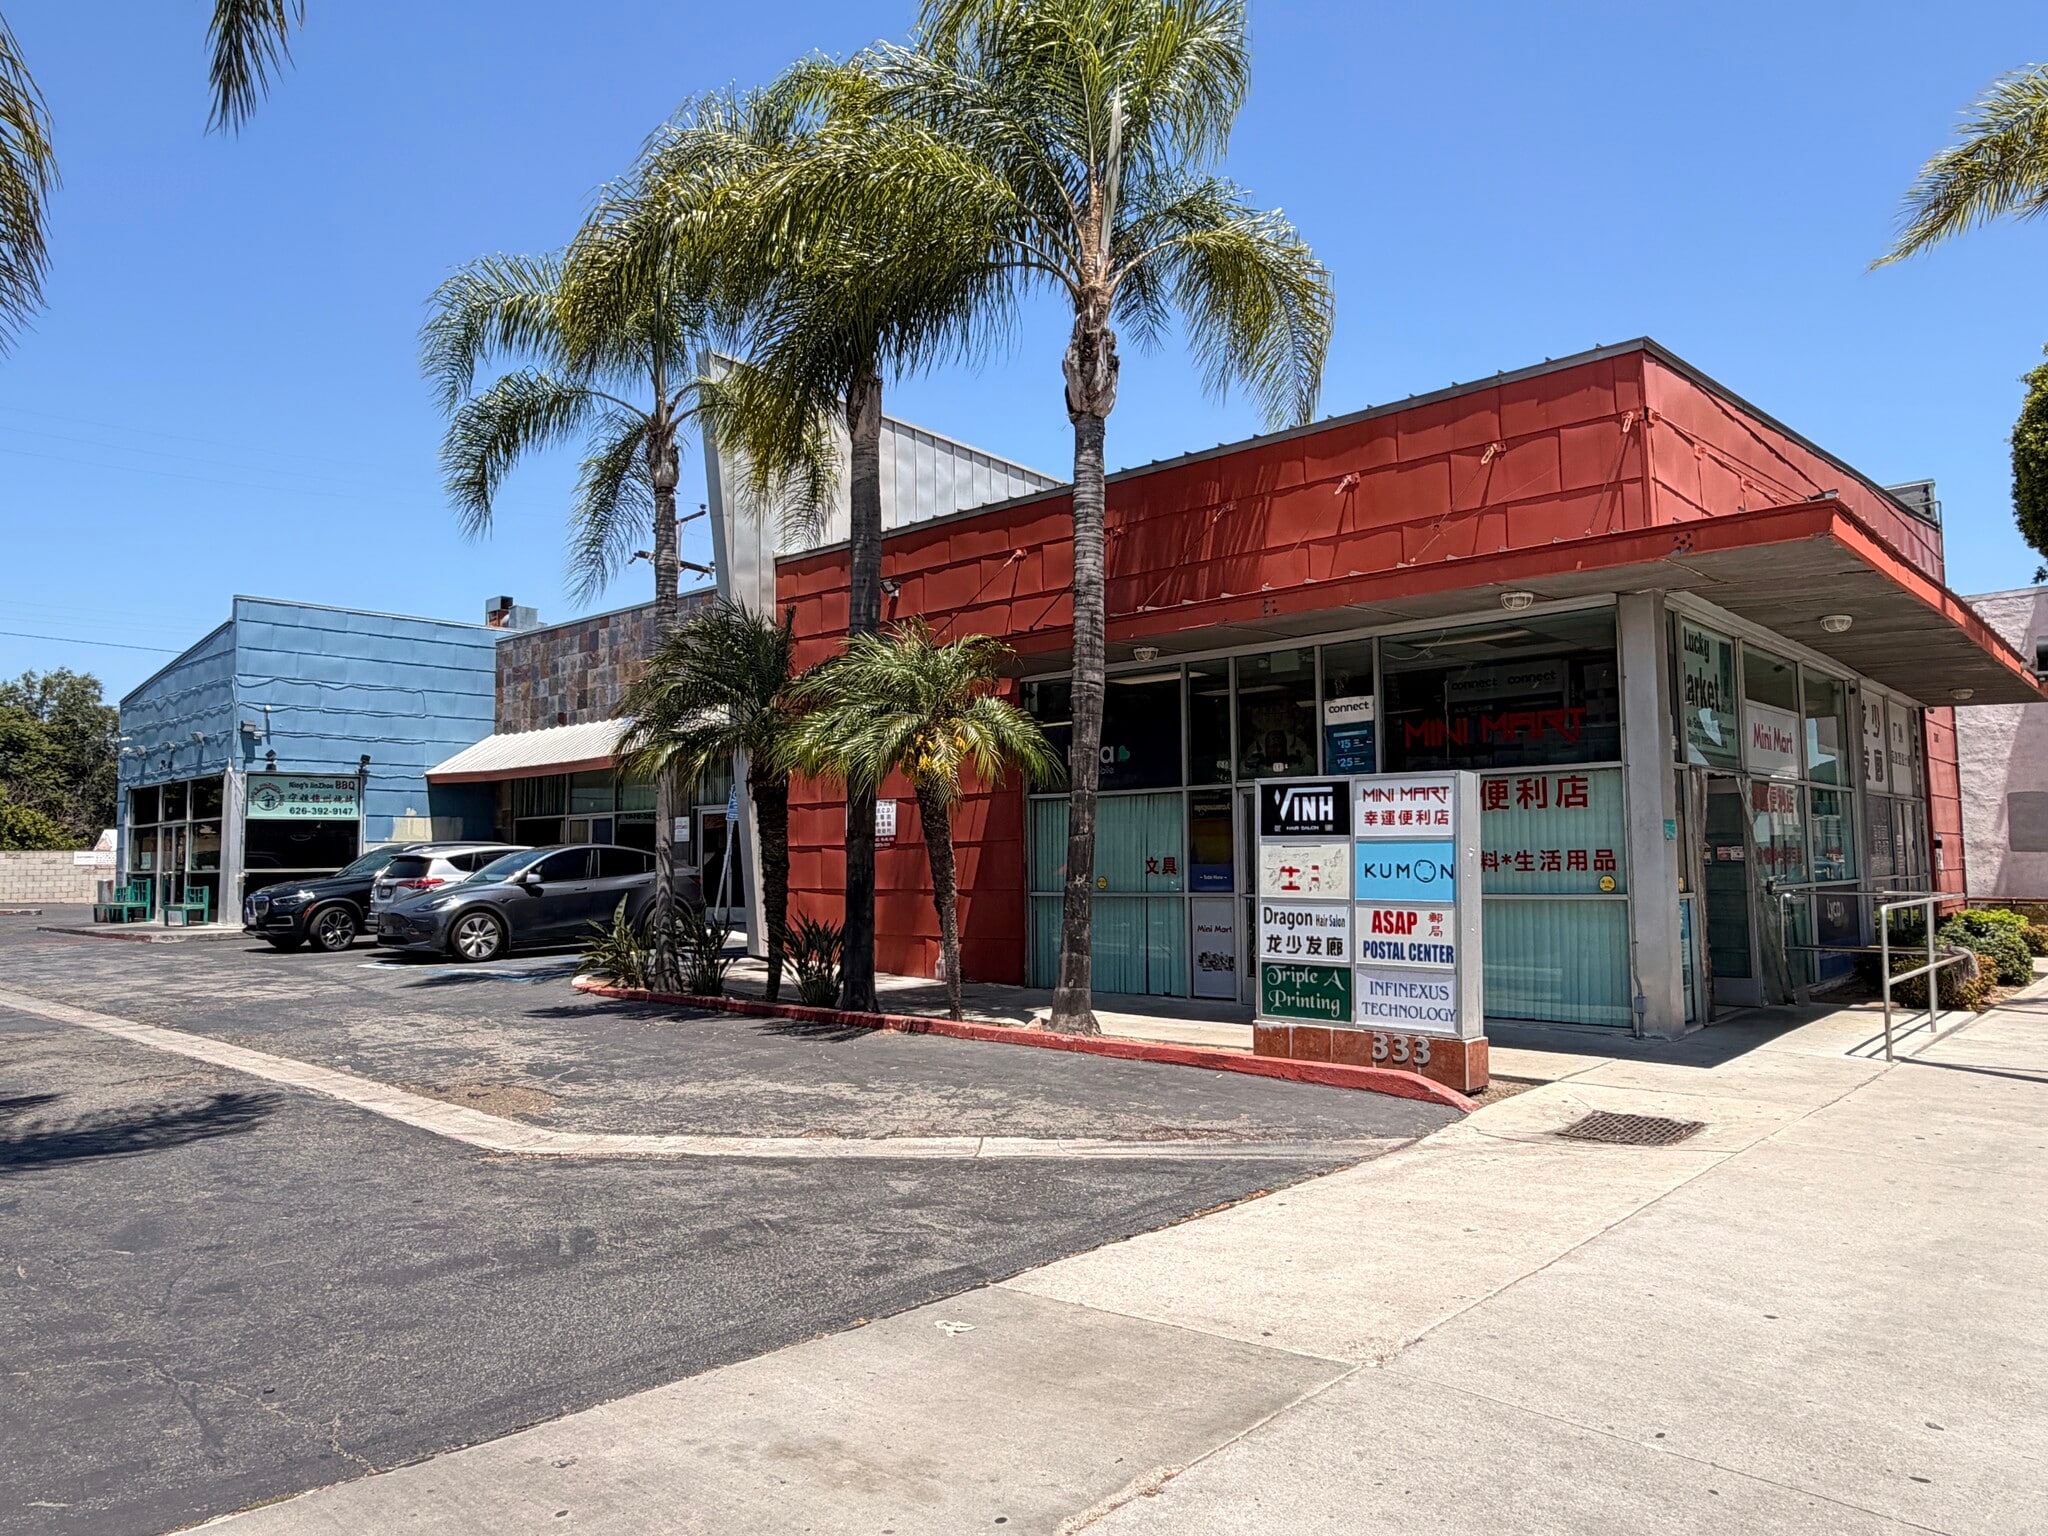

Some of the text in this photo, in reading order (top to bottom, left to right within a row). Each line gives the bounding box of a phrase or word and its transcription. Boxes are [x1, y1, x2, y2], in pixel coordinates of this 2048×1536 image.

[1682, 626, 1710, 663] Lucky
[1451, 670, 1558, 691] connect connect
[1328, 700, 1370, 714] connect
[1403, 708, 1587, 749] MINI MART
[1753, 723, 1772, 751] Mini
[1773, 727, 1793, 754] Mart
[335, 780, 355, 791] BBQ
[1363, 786, 1450, 804] MINI MART
[1480, 774, 1589, 812] 便利店
[289, 806, 354, 816] 626-392-9147
[1274, 786, 1334, 821] VINH
[1364, 809, 1450, 826] 幸運便利店
[1145, 856, 1177, 875] 文具
[1364, 859, 1454, 883] KUMON
[1197, 924, 1232, 933] Mini Mart
[1263, 906, 1346, 930] Dragon Hair Salon
[1371, 910, 1418, 935] ASAP
[1266, 933, 1343, 957] 龙少发廊
[1363, 940, 1455, 964] POSTAL CENTER
[1266, 965, 1346, 991] Triple A
[1369, 981, 1450, 1001] INFINEXUS
[1268, 989, 1341, 1018] Printing
[1361, 1001, 1457, 1022] TECHNOLOGY
[1371, 1032, 1432, 1067] 333
